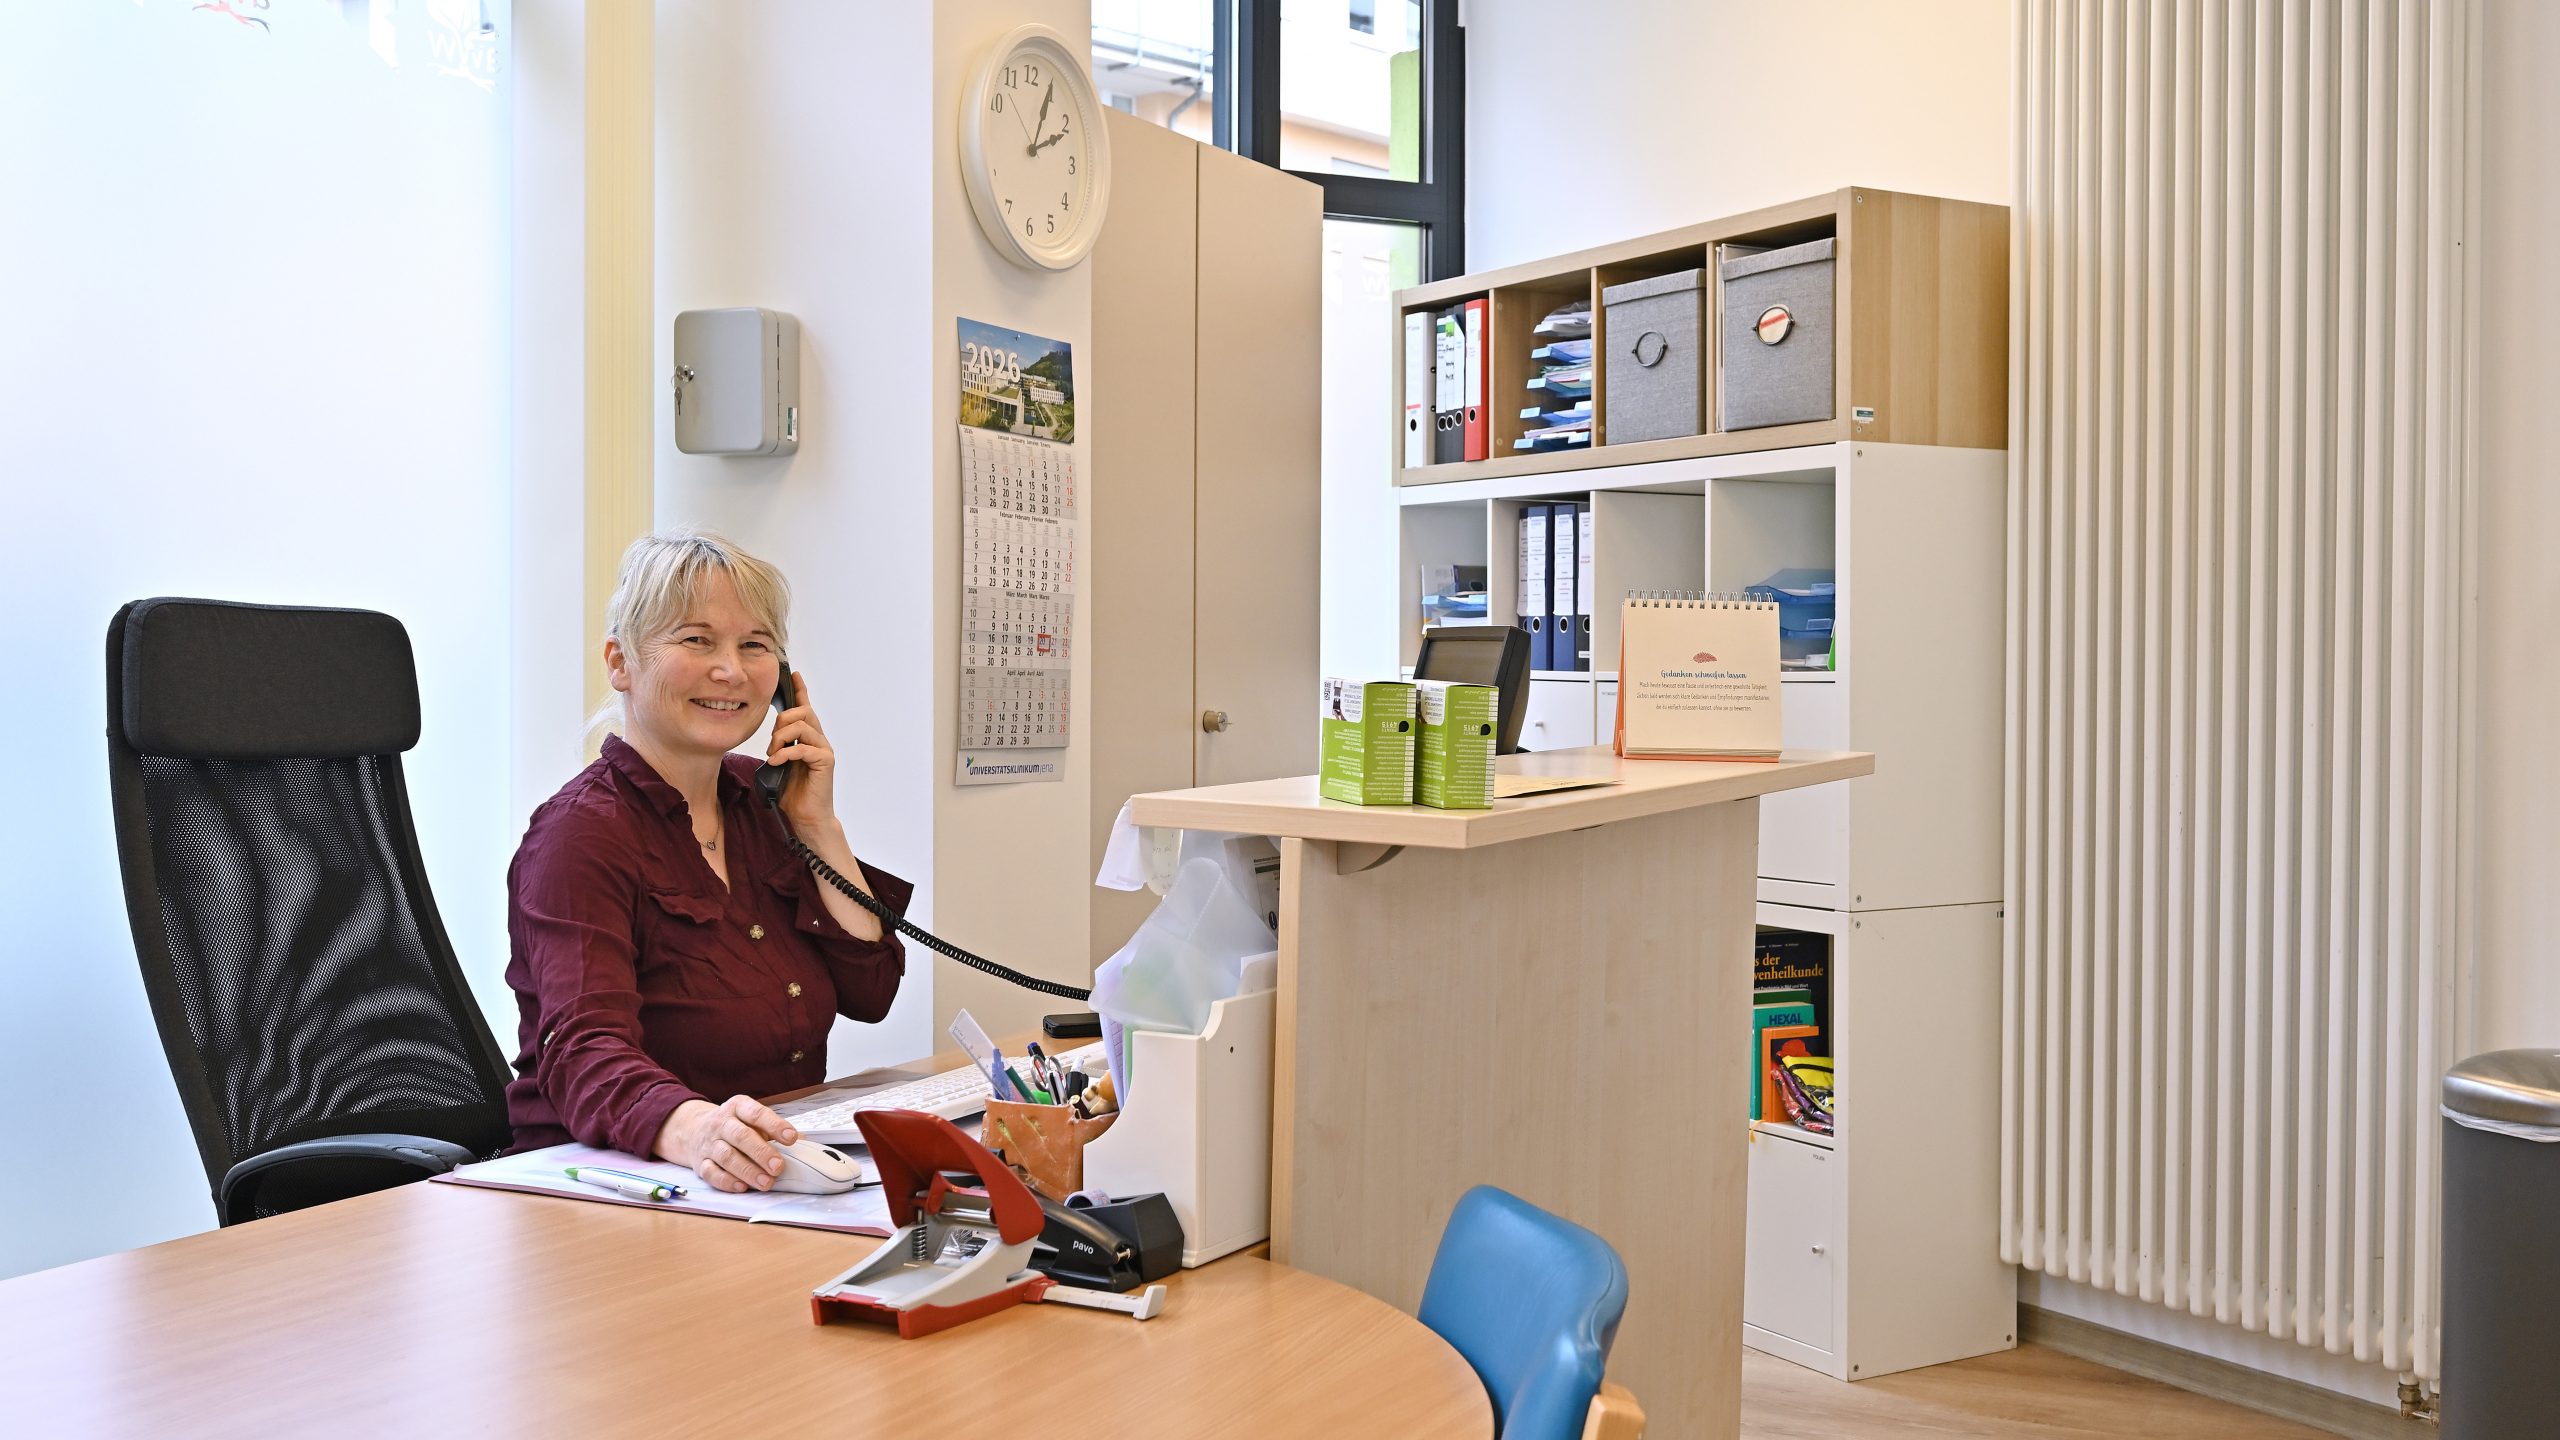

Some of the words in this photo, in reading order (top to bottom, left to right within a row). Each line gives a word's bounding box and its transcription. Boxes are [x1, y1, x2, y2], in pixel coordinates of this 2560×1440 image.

[1004, 66, 1018, 90] 11
[1024, 64, 1038, 86] 12
[1062, 114, 1069, 133] 2
[1069, 156, 1075, 175] 3
[1005, 199, 1012, 215] 7
[1061, 192, 1069, 210] 4
[1026, 218, 1033, 236] 6
[1047, 214, 1054, 233] 5
[966, 342, 1020, 383] 2026
[1044, 461, 1046, 469] 2
[992, 464, 995, 472] 5
[1018, 468, 1021, 476] 7
[1032, 470, 1034, 478] 8
[1044, 472, 1047, 480] 9
[989, 475, 995, 484] 12
[1003, 477, 1009, 486] 13
[990, 487, 996, 495] 19
[1003, 489, 1009, 497] 20
[1016, 491, 1022, 499] 21
[1029, 492, 1035, 501] 22
[1042, 495, 1048, 503] 23
[990, 498, 996, 507] 26
[1003, 500, 1009, 509] 27
[1016, 502, 1022, 511] 28
[1030, 504, 1035, 512] 29
[1042, 506, 1048, 514] 30
[993, 543, 996, 551] 2
[1045, 549, 1048, 557] 6
[993, 555, 996, 563] 9
[1004, 556, 1009, 564] 10
[1030, 559, 1035, 567] 12
[1042, 560, 1048, 568] 13
[990, 567, 996, 575] 16
[1030, 570, 1035, 578] 19
[989, 578, 996, 586] 23
[1003, 579, 1009, 587] 24
[1016, 580, 1022, 589] 25
[1029, 582, 1035, 590] 26
[1041, 583, 1047, 591] 27
[1044, 614, 1046, 622] 6
[992, 622, 995, 630] 9
[1003, 623, 1008, 631] 10
[1029, 625, 1034, 633] 12
[989, 634, 995, 642] 16
[1016, 636, 1021, 644] 18
[988, 646, 994, 654] 23
[1015, 647, 1020, 655] 25
[1027, 648, 1033, 656] 26
[988, 658, 994, 666] 30
[1001, 658, 1007, 666] 31
[1661, 670, 1693, 678] Gedanken
[1695, 670, 1725, 679] schweifen
[1015, 702, 1018, 710] 8
[1012, 714, 1018, 722] 15
[985, 725, 991, 733] 20
[998, 725, 1004, 733] 21
[1011, 725, 1017, 733] 22
[1024, 725, 1030, 733] 23
[984, 737, 990, 745] 27
[997, 737, 1003, 745] 28
[1010, 737, 1016, 745] 29
[1023, 736, 1029, 745] 30
[1762, 952, 1780, 966] der
[1769, 1013, 1803, 1025] HEXAL
[1073, 1240, 1094, 1254] pavo
